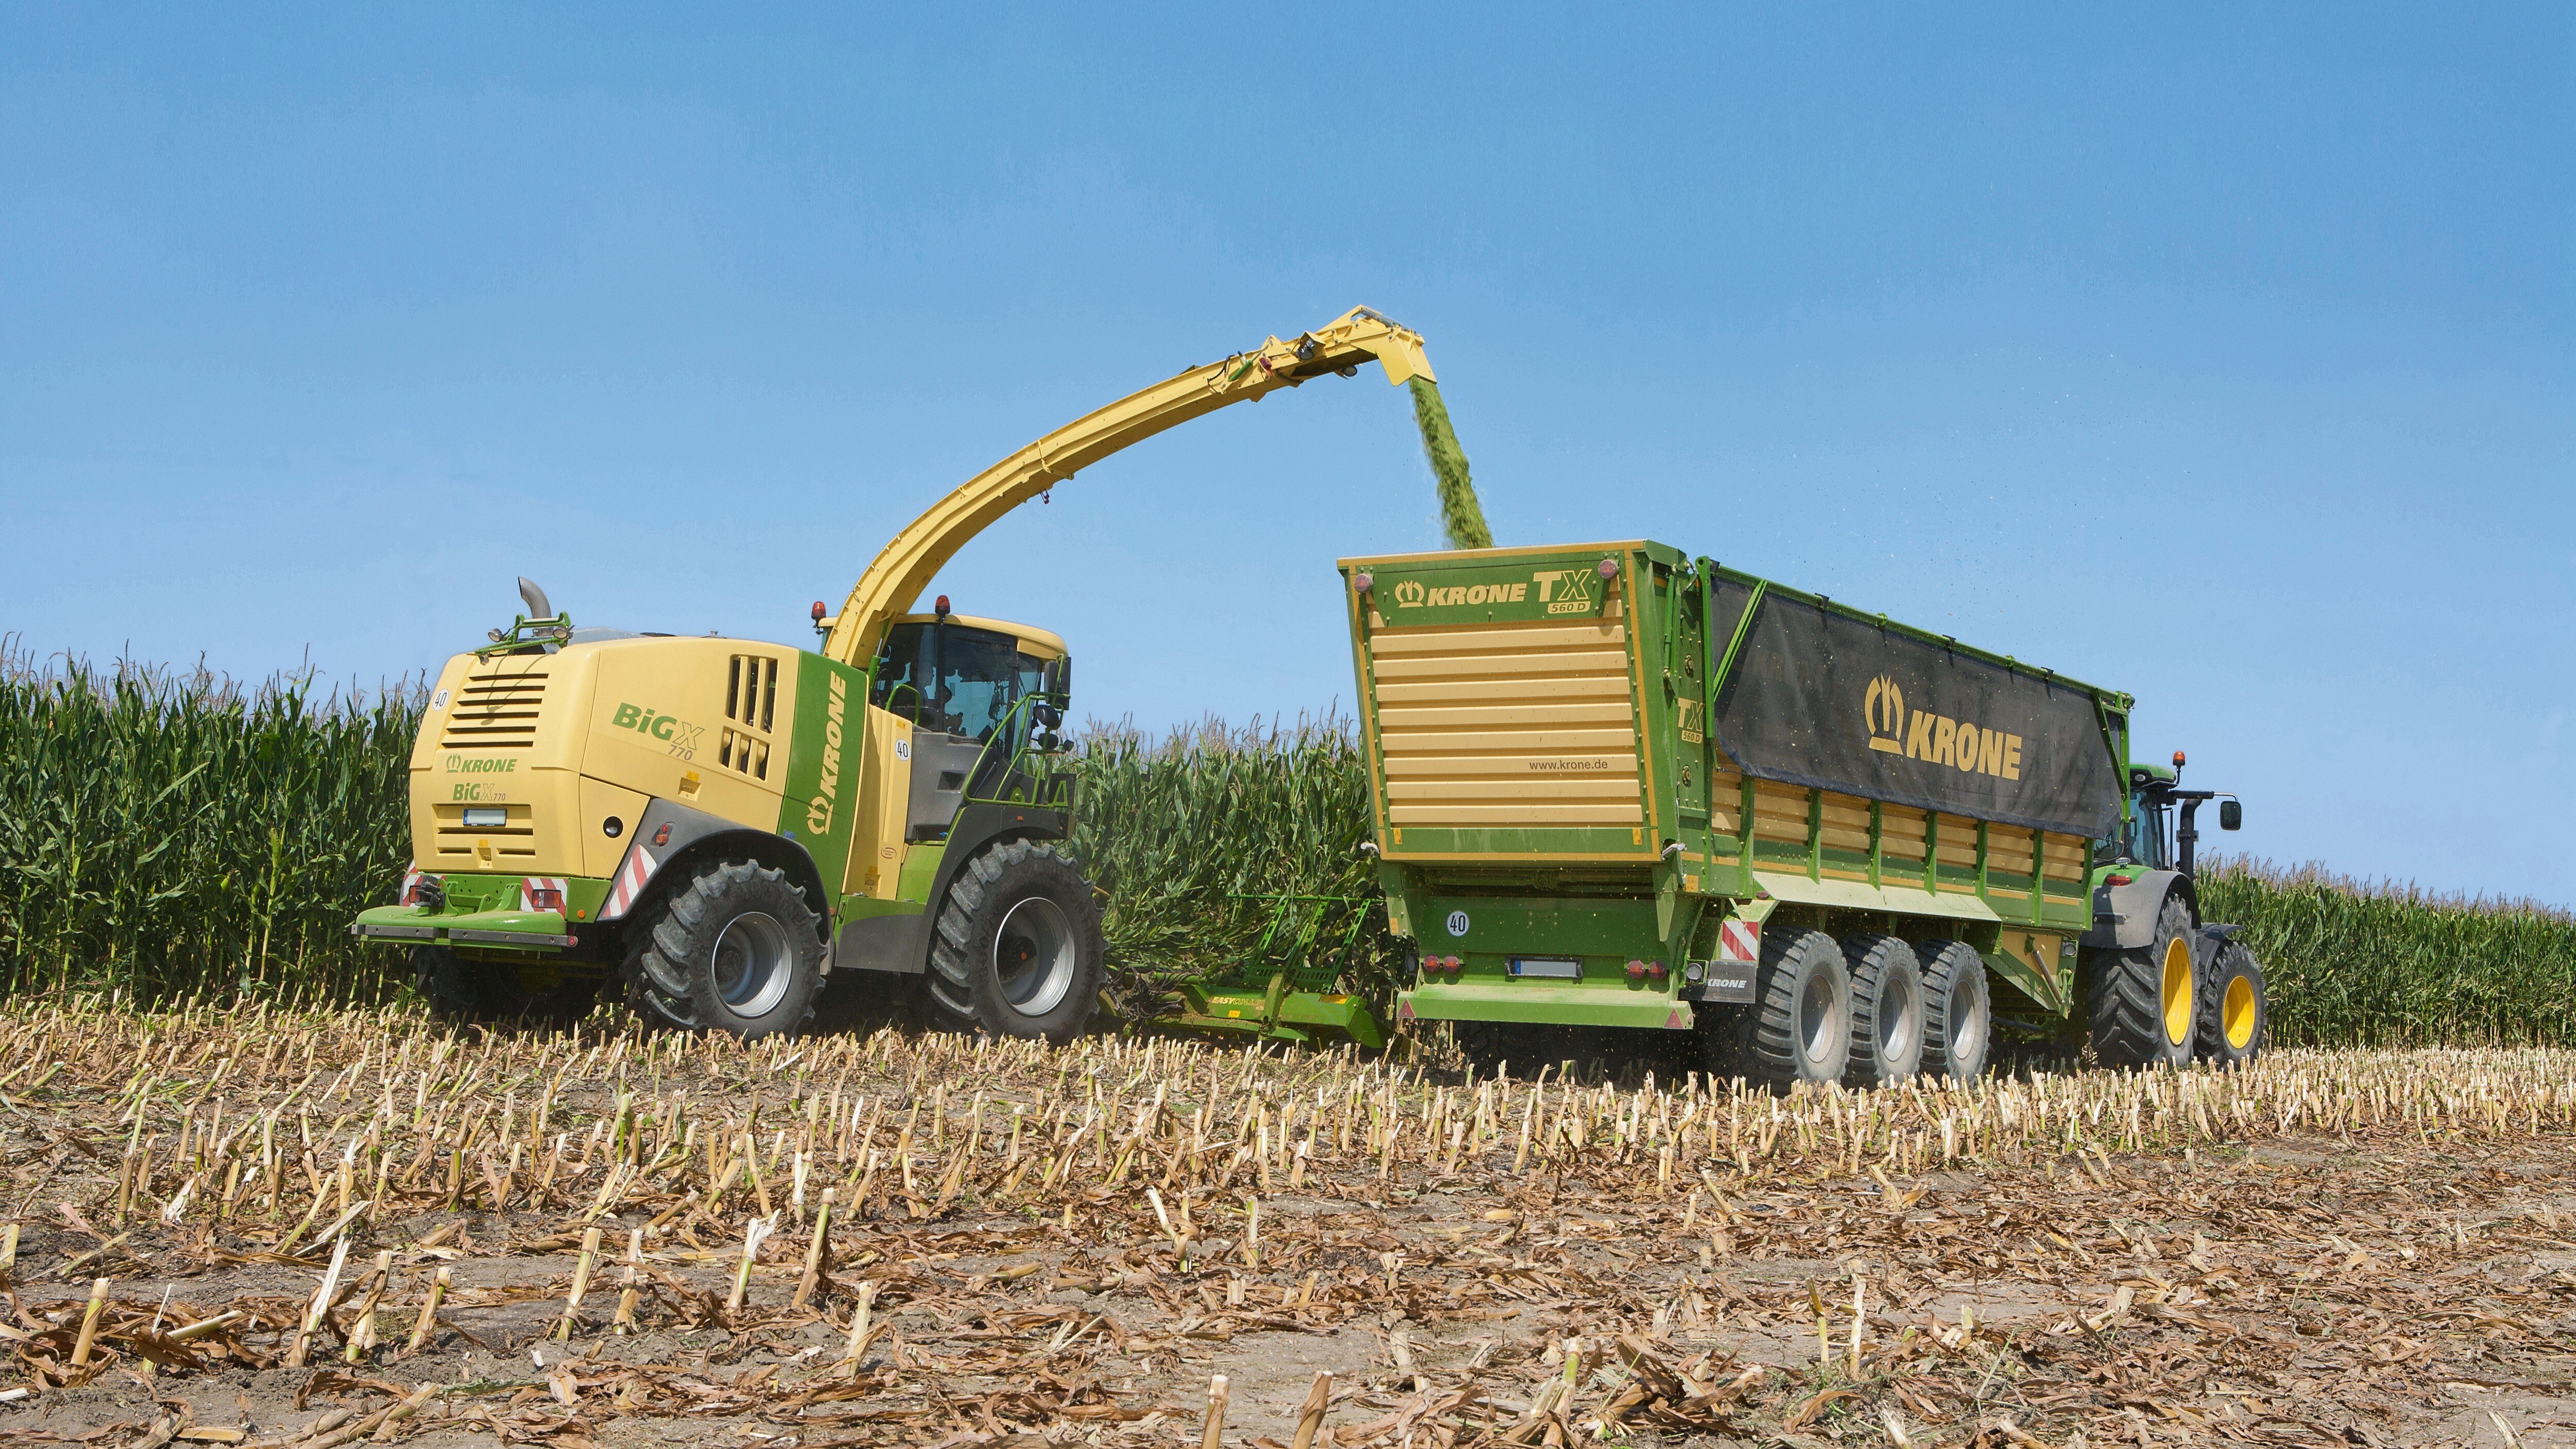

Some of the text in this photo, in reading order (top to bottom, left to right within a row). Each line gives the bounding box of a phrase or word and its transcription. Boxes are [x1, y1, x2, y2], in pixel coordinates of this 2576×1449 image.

[1533, 569, 1592, 602] TX
[1427, 583, 1527, 606] KRONE
[1551, 603, 1586, 613] 560 D
[434, 692, 447, 707] 40
[1678, 697, 1705, 732] TX
[820, 670, 846, 799] KRONE
[1683, 732, 1694, 741] 560
[668, 744, 693, 761] 770
[897, 742, 908, 758] 40
[1906, 710, 2022, 780] KRONE
[461, 759, 517, 772] KRONE
[1529, 759, 1608, 769] www.krone.de
[493, 793, 506, 801] 770
[1450, 915, 1466, 932] 40
[1707, 978, 1747, 988] KRONE
